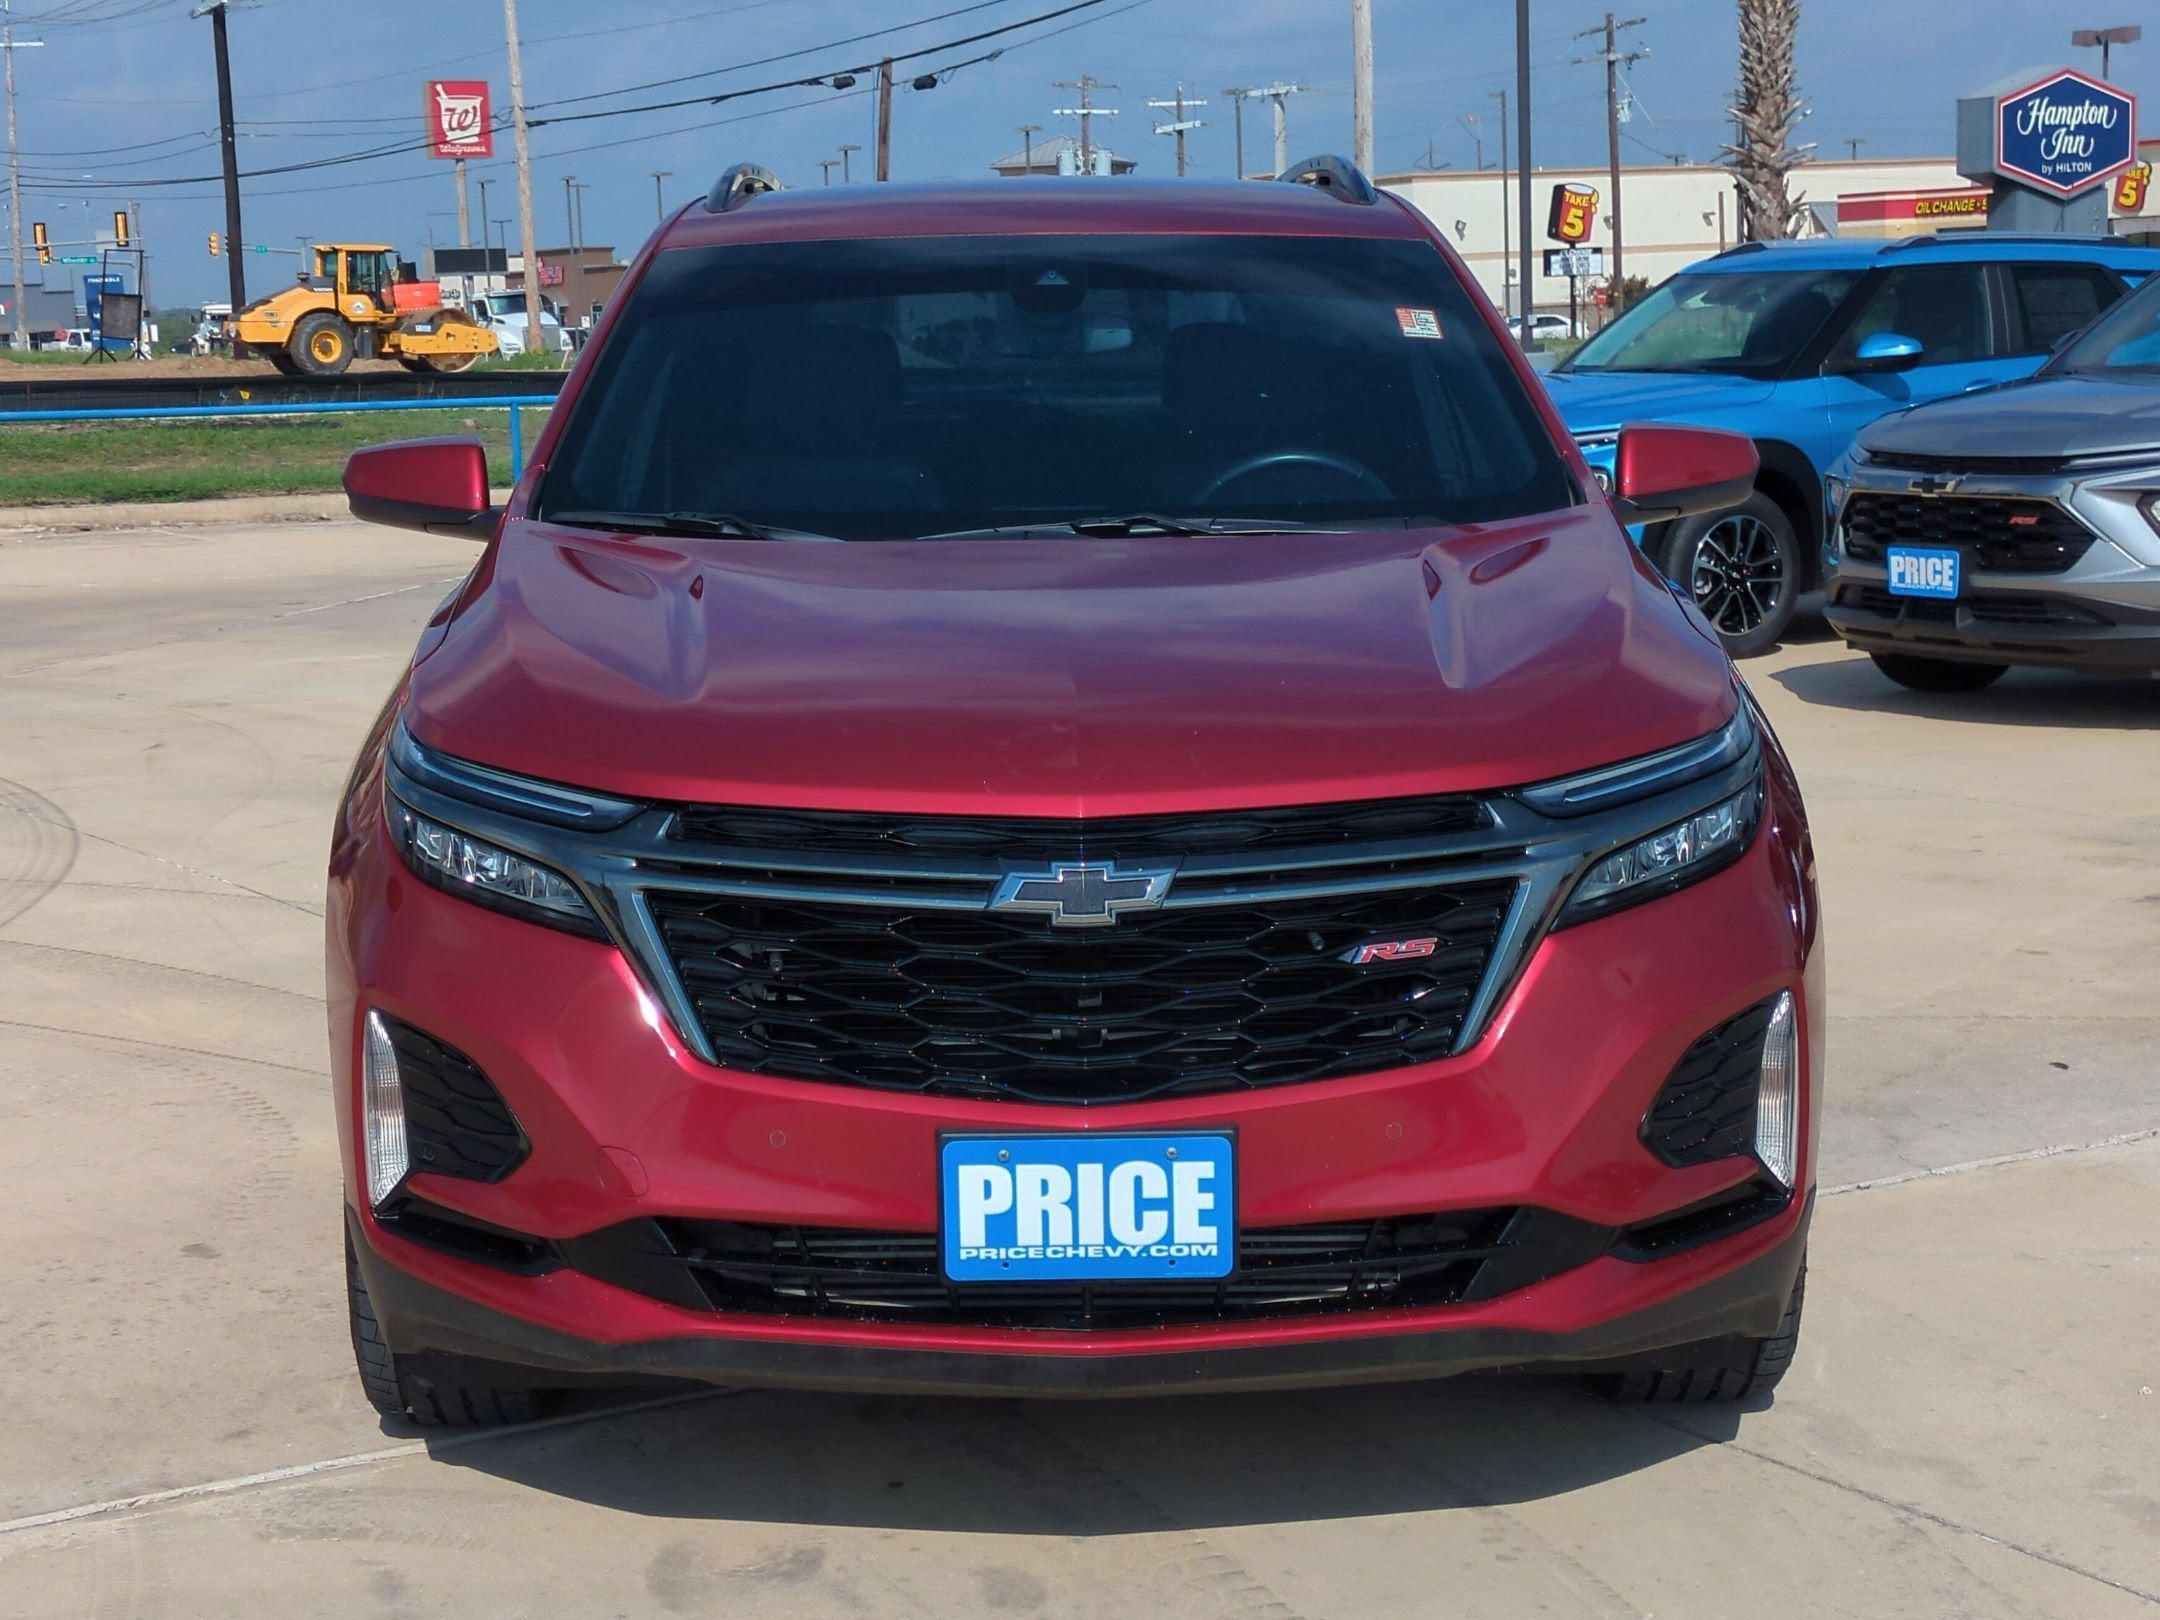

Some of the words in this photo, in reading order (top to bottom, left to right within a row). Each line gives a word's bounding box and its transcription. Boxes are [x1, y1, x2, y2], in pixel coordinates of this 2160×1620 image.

[2017, 96, 2117, 135] Hampton
[2041, 127, 2094, 160] Inn
[2041, 164, 2053, 176] by
[2056, 161, 2092, 173] HILTON
[1564, 191, 1589, 207] TAKE
[2119, 180, 2137, 206] 5
[1915, 202, 1931, 214] OIL
[1932, 199, 1976, 213] CHANGE
[1562, 208, 1585, 238] 5
[1890, 555, 1954, 588] PRICE
[1360, 937, 1438, 963] RS
[958, 1160, 1218, 1247] PRICE
[960, 1243, 1218, 1261] PRICECHEVY.COM
